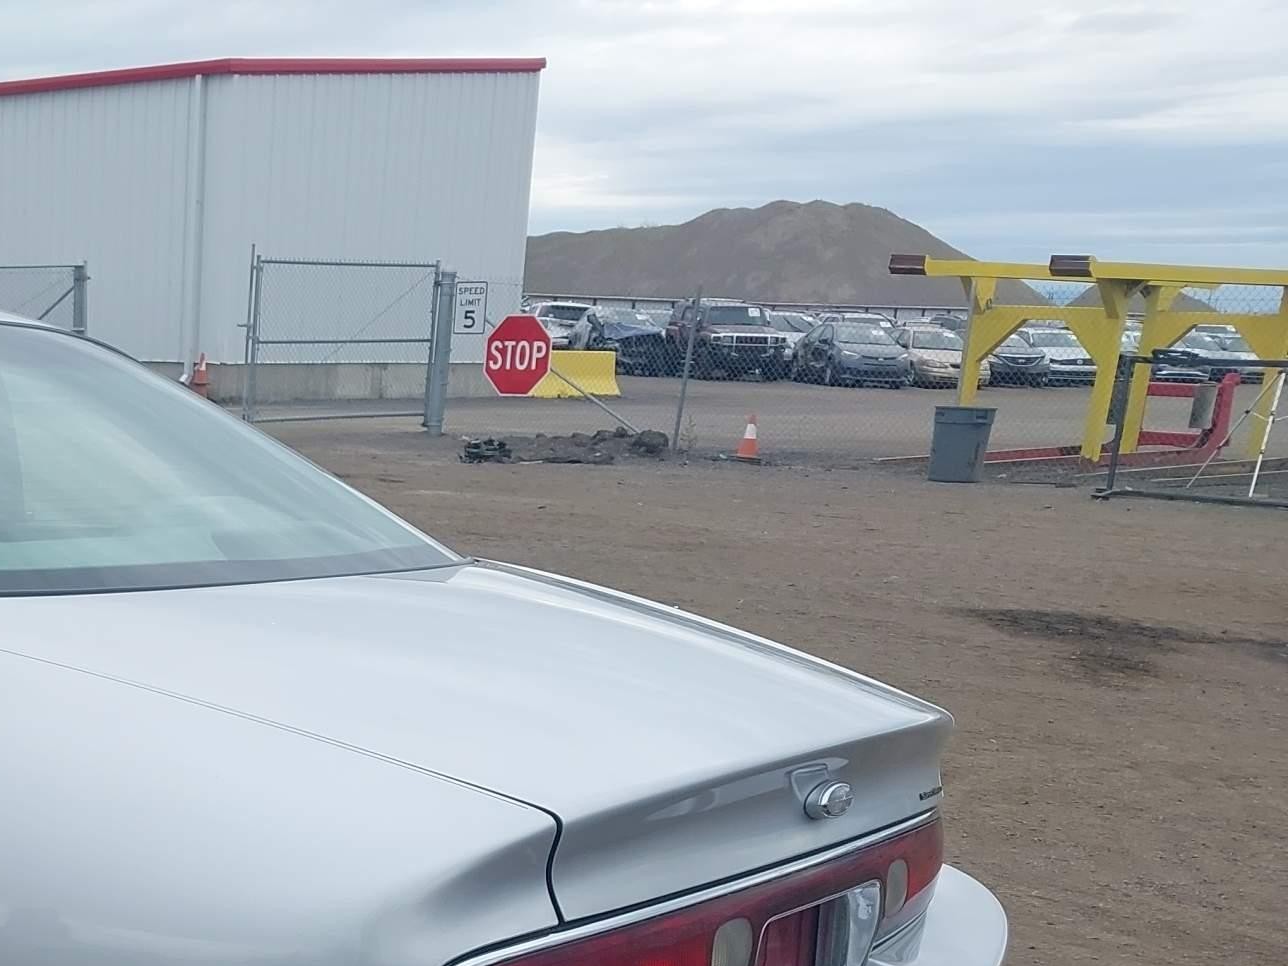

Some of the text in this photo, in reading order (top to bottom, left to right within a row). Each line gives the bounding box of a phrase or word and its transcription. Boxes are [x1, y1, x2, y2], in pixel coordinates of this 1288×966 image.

[458, 287, 485, 295] SPEED
[460, 298, 481, 306] LIMIT
[463, 310, 476, 328] 5
[489, 340, 547, 370] STOP
